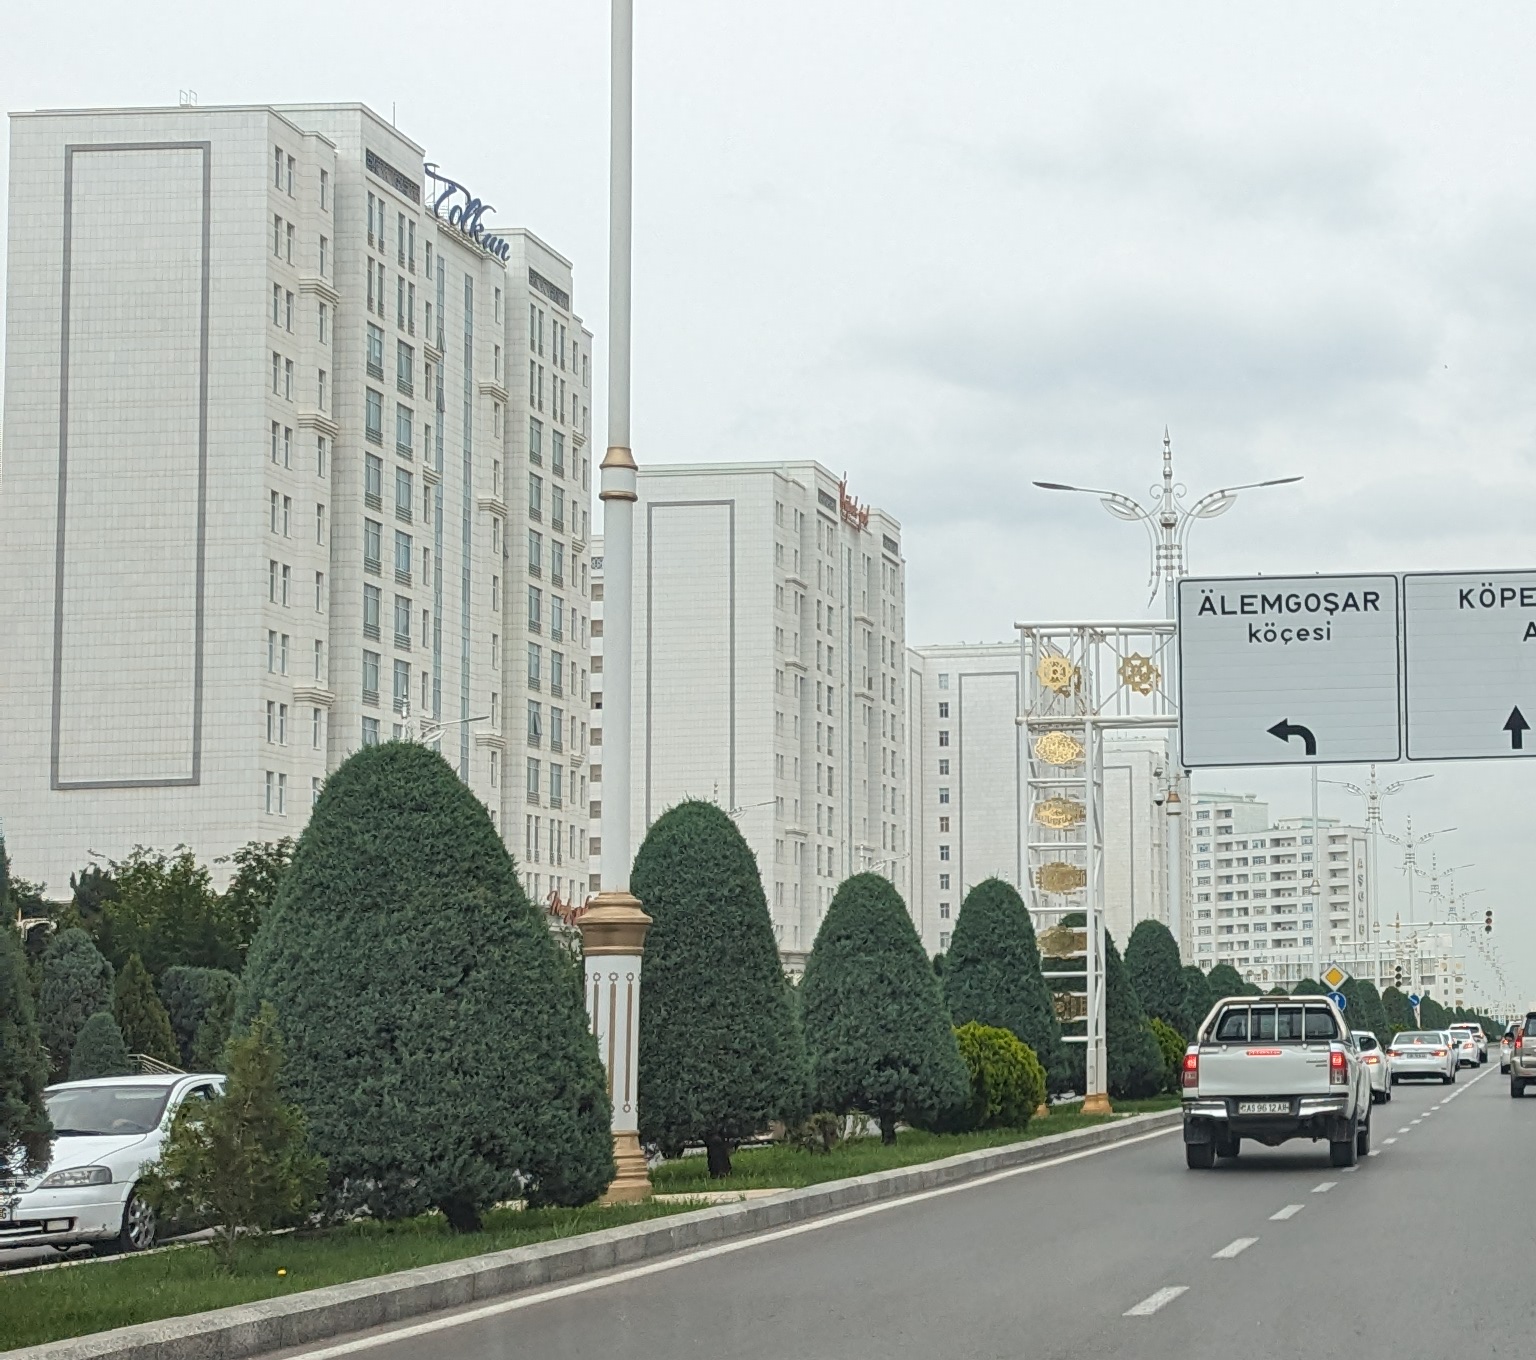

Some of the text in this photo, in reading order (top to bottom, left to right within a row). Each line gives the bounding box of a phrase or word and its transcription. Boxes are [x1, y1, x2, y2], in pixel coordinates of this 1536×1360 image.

[423, 162, 511, 262] Tolkun
[1197, 588, 1380, 617] ÄLEMGOŞAR
[1248, 620, 1331, 646] köçesi
